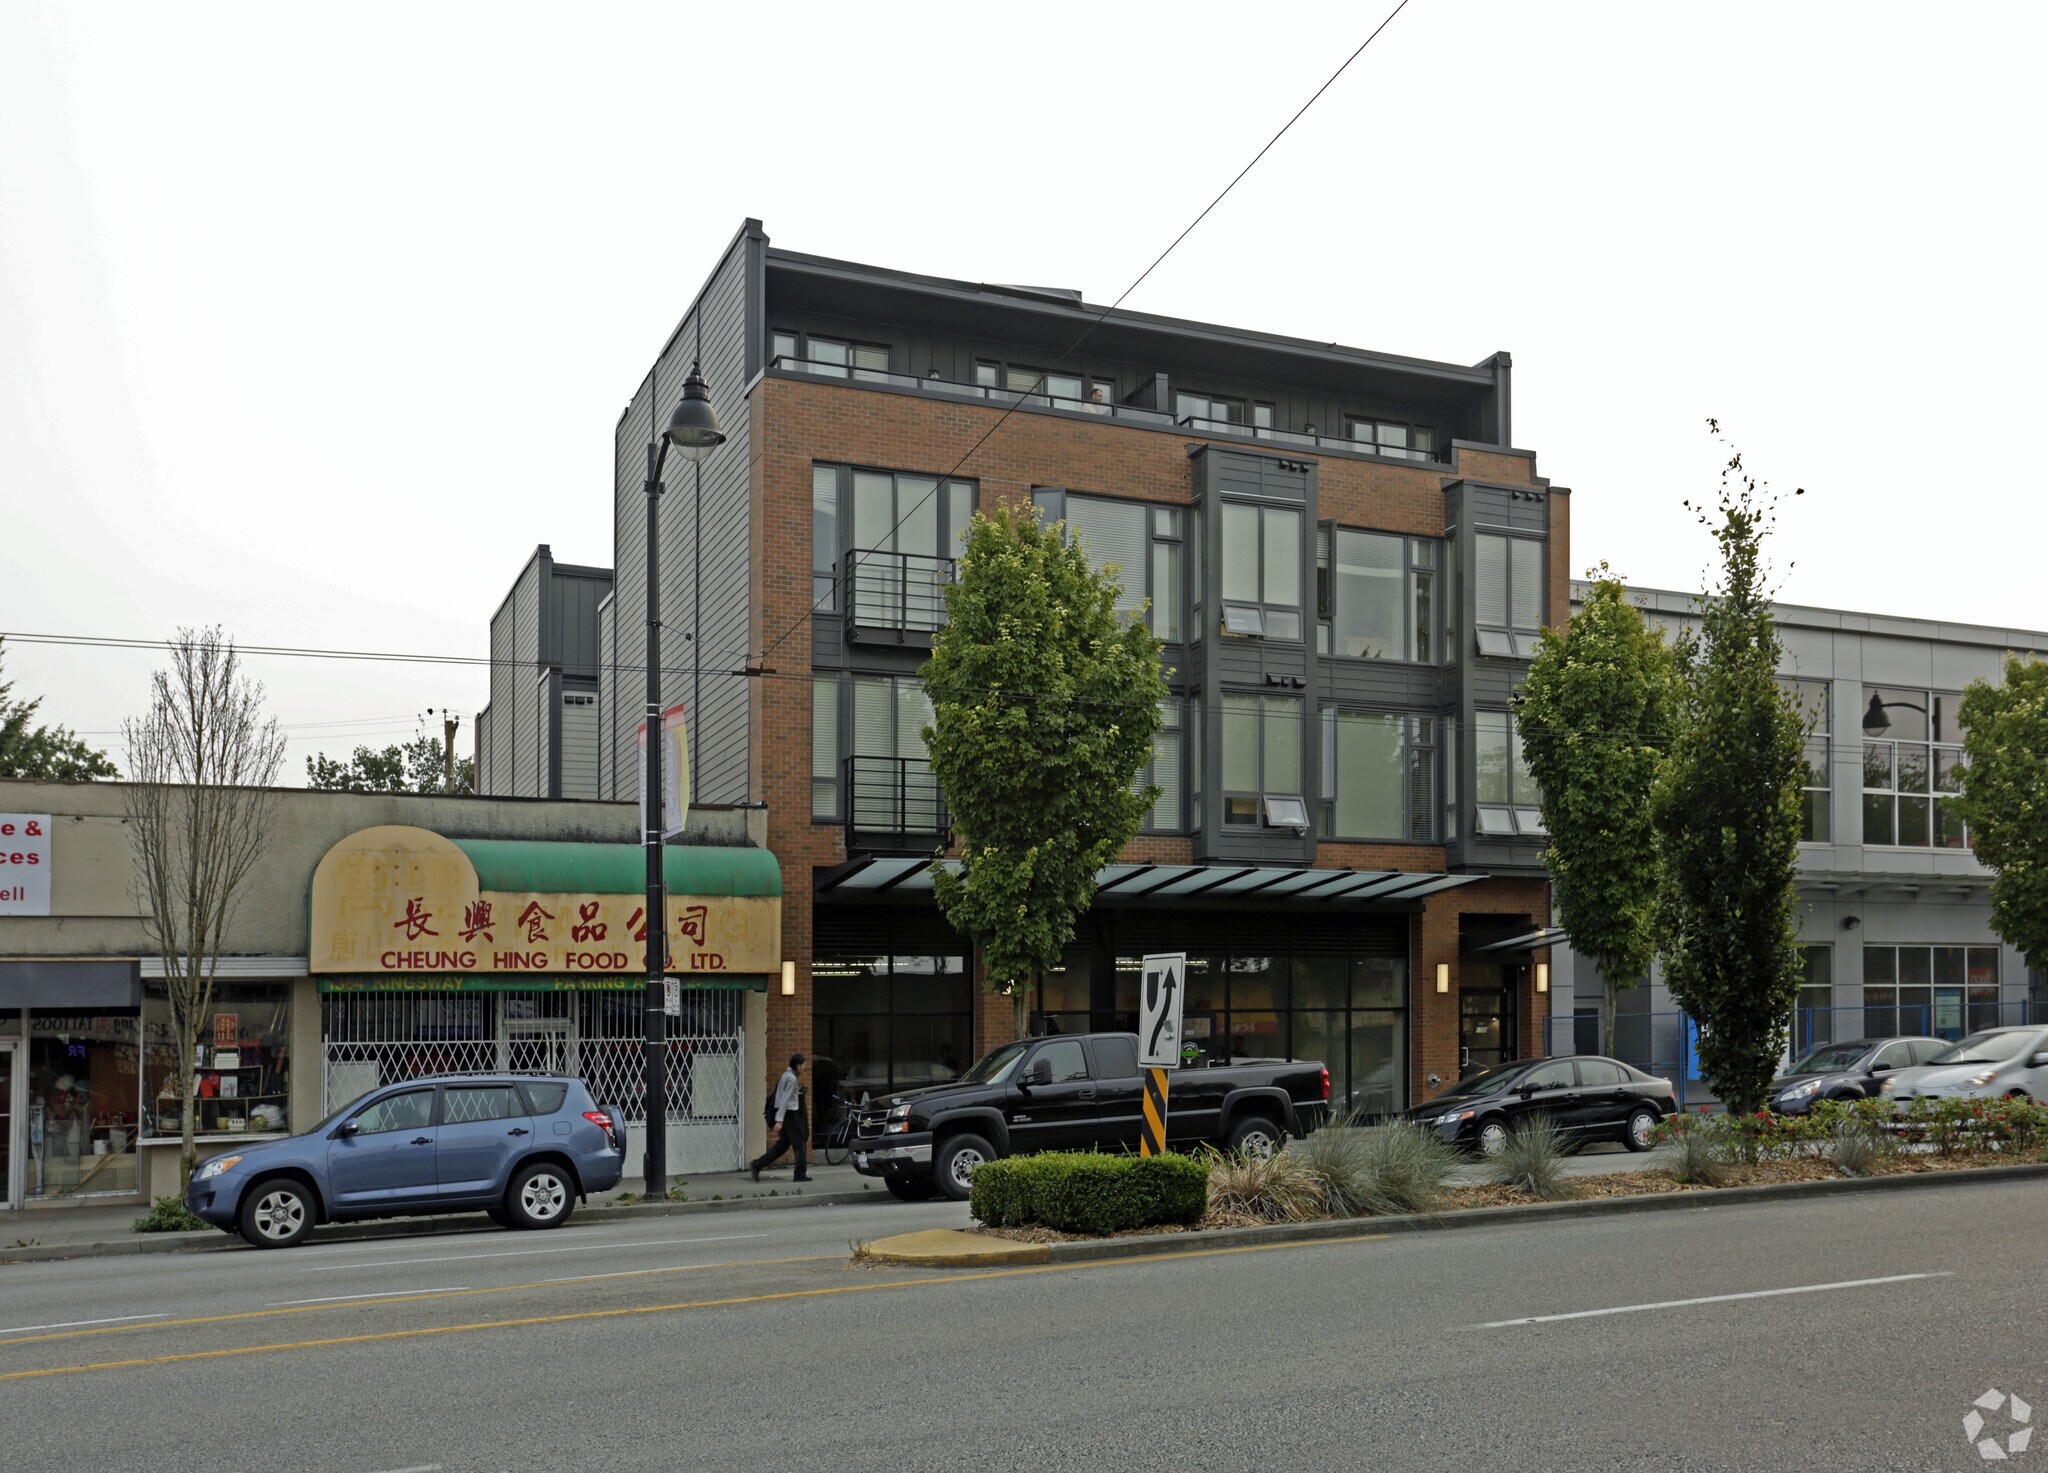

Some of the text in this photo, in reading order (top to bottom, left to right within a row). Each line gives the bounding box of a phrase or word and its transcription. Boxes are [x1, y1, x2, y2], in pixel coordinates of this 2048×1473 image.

[25, 820, 42, 836] &
[380, 951, 477, 969] CHEUNG
[493, 951, 549, 969] HING
[565, 951, 628, 970] FOOD
[690, 953, 727, 970] LTD.
[372, 976, 464, 991] KINGSWAY
